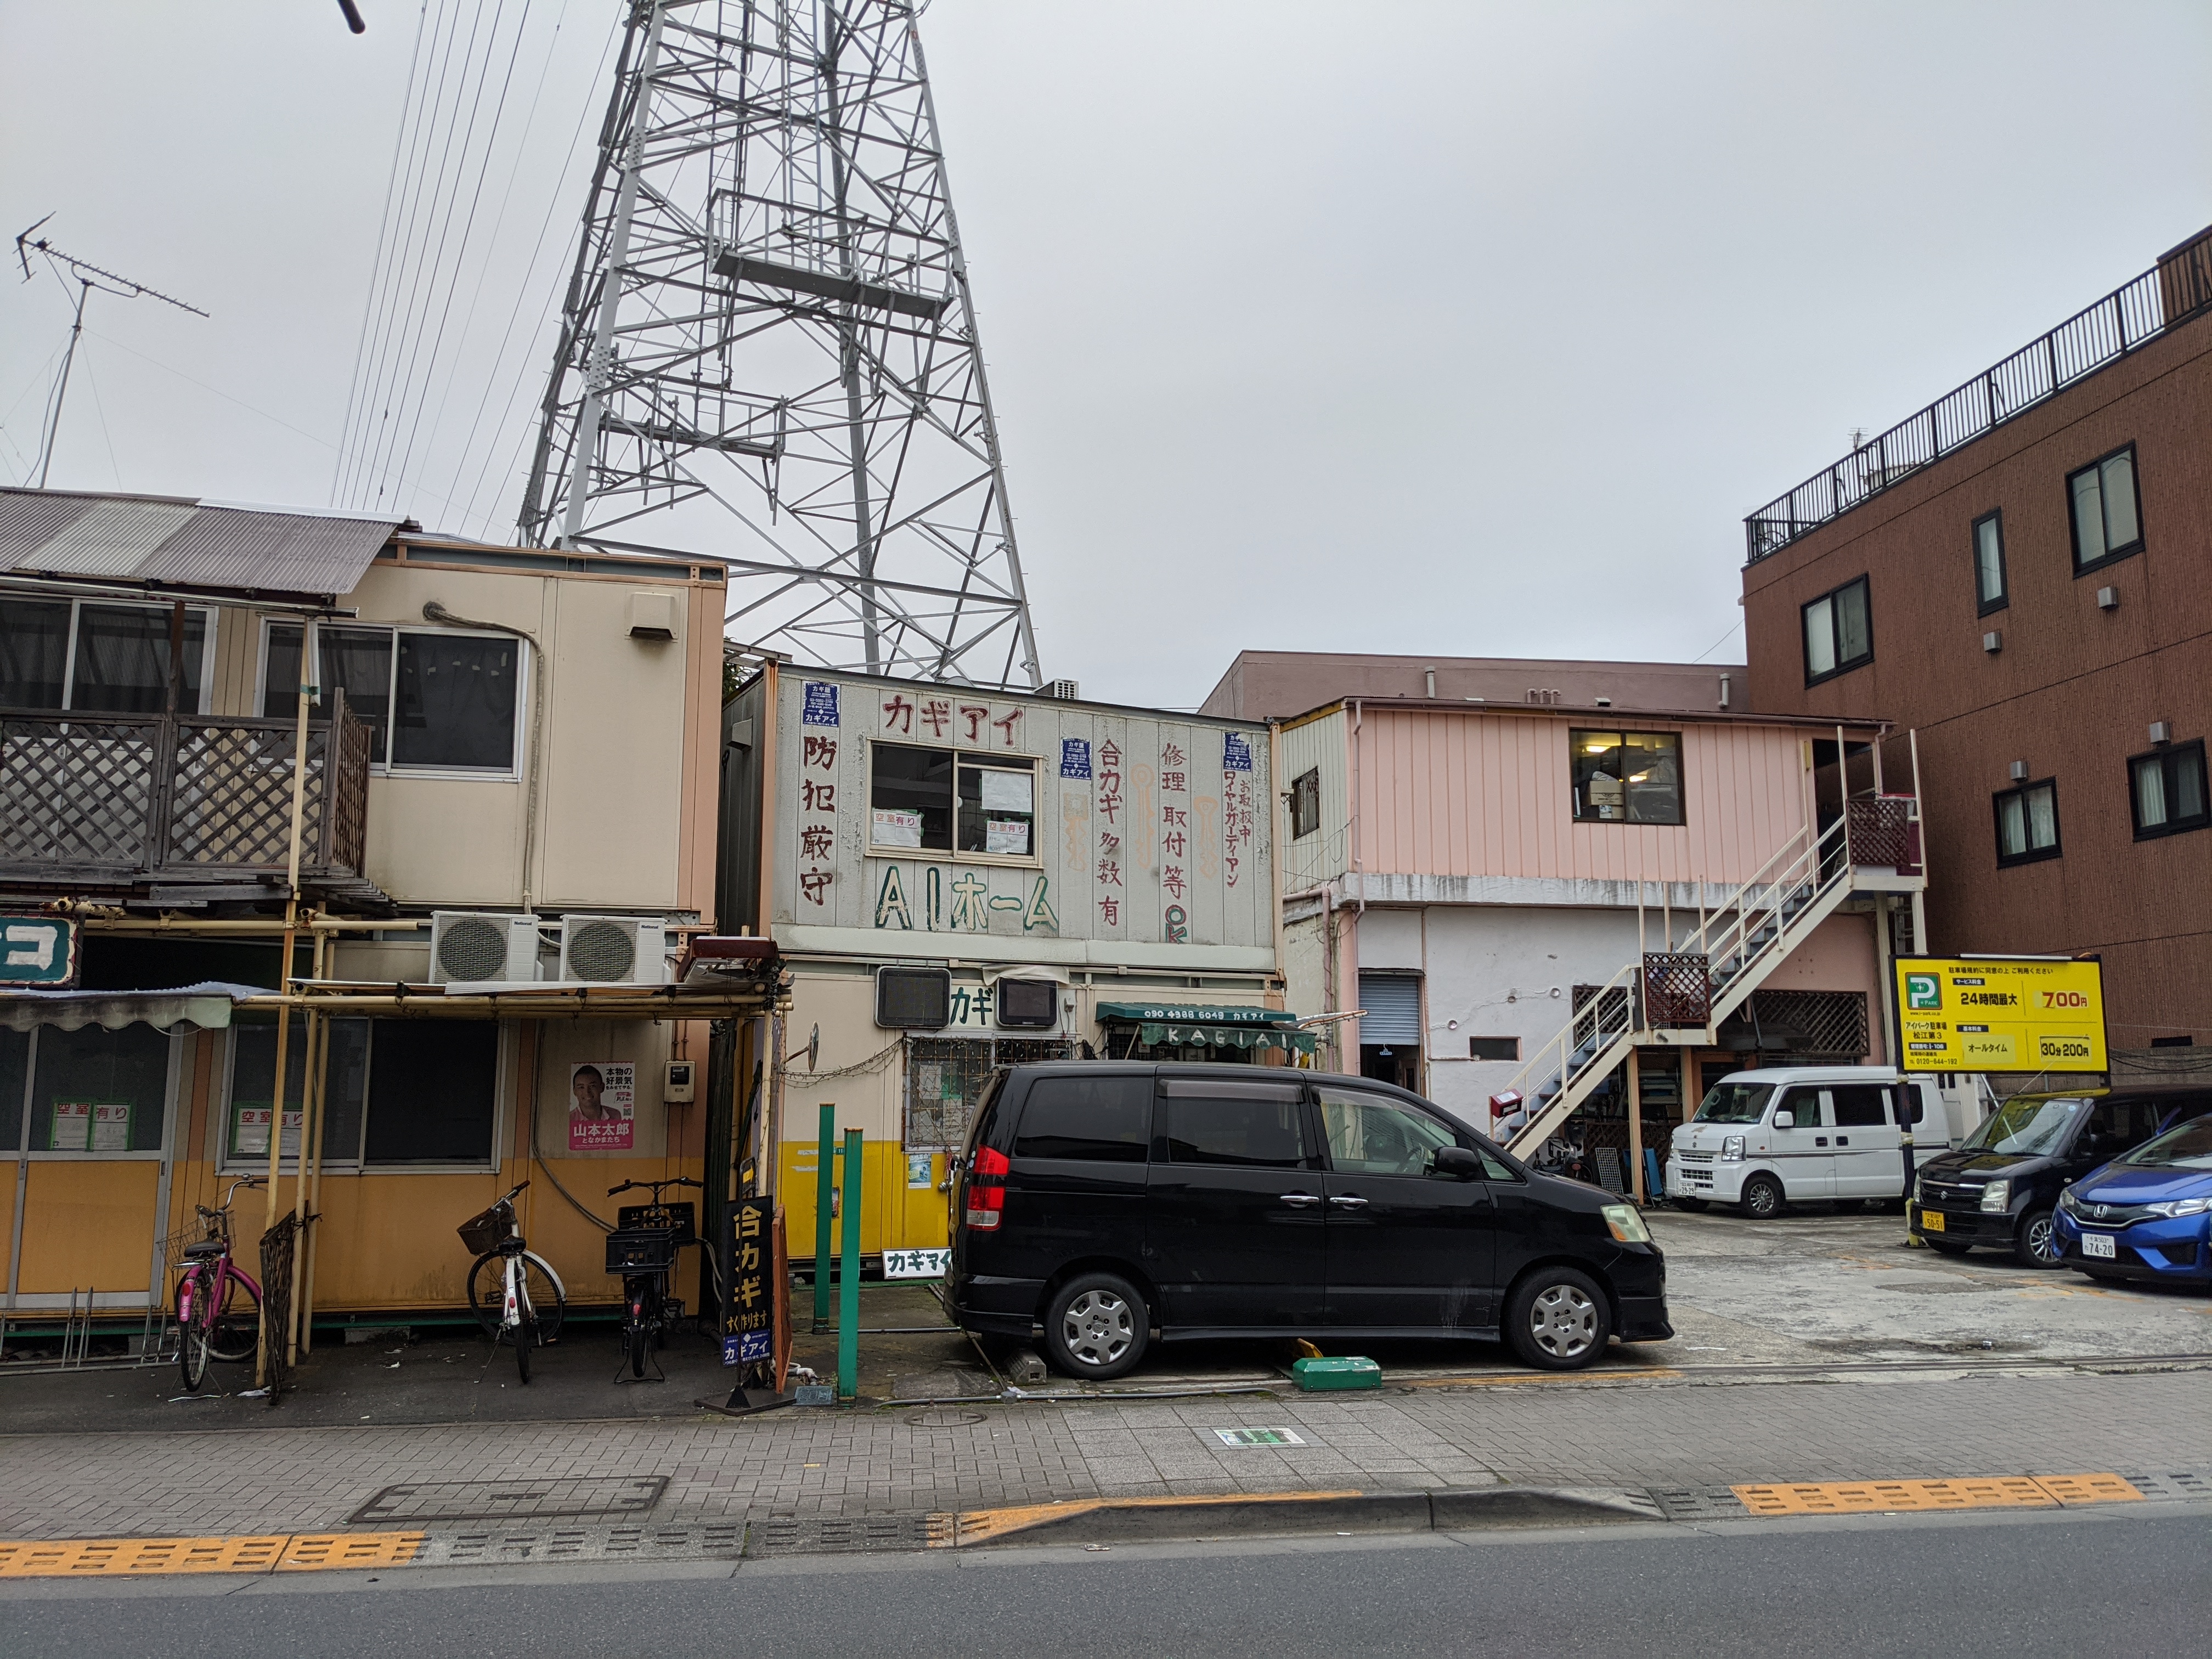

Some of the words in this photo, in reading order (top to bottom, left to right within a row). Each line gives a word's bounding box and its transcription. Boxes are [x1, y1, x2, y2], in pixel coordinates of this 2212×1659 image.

[805, 714, 836, 724] カギアイ
[883, 695, 1023, 746] カギアイ
[1225, 760, 1249, 768] カギアイ
[1063, 768, 1089, 777] カギアイ
[799, 735, 837, 906] 防犯厳守
[876, 813, 915, 826] 空室有り
[989, 823, 1025, 833] 空室有り
[0, 926, 58, 970] コ
[1910, 977, 1936, 1008] P
[1960, 992, 2018, 1006] 24時間最大
[950, 987, 994, 1025] カギ
[2042, 992, 2087, 1008] 700円
[1199, 1012, 1224, 1020] 6049
[1233, 1012, 1263, 1020] カギアイ
[1968, 1043, 2007, 1053] オールタイム
[574, 1123, 629, 1137] 山本太郎
[1927, 1218, 1942, 1230] 50-51
[2089, 1243, 2113, 1255] 74-20
[733, 1206, 763, 1308] 合カギ
[888, 1250, 950, 1272] カギアイ
